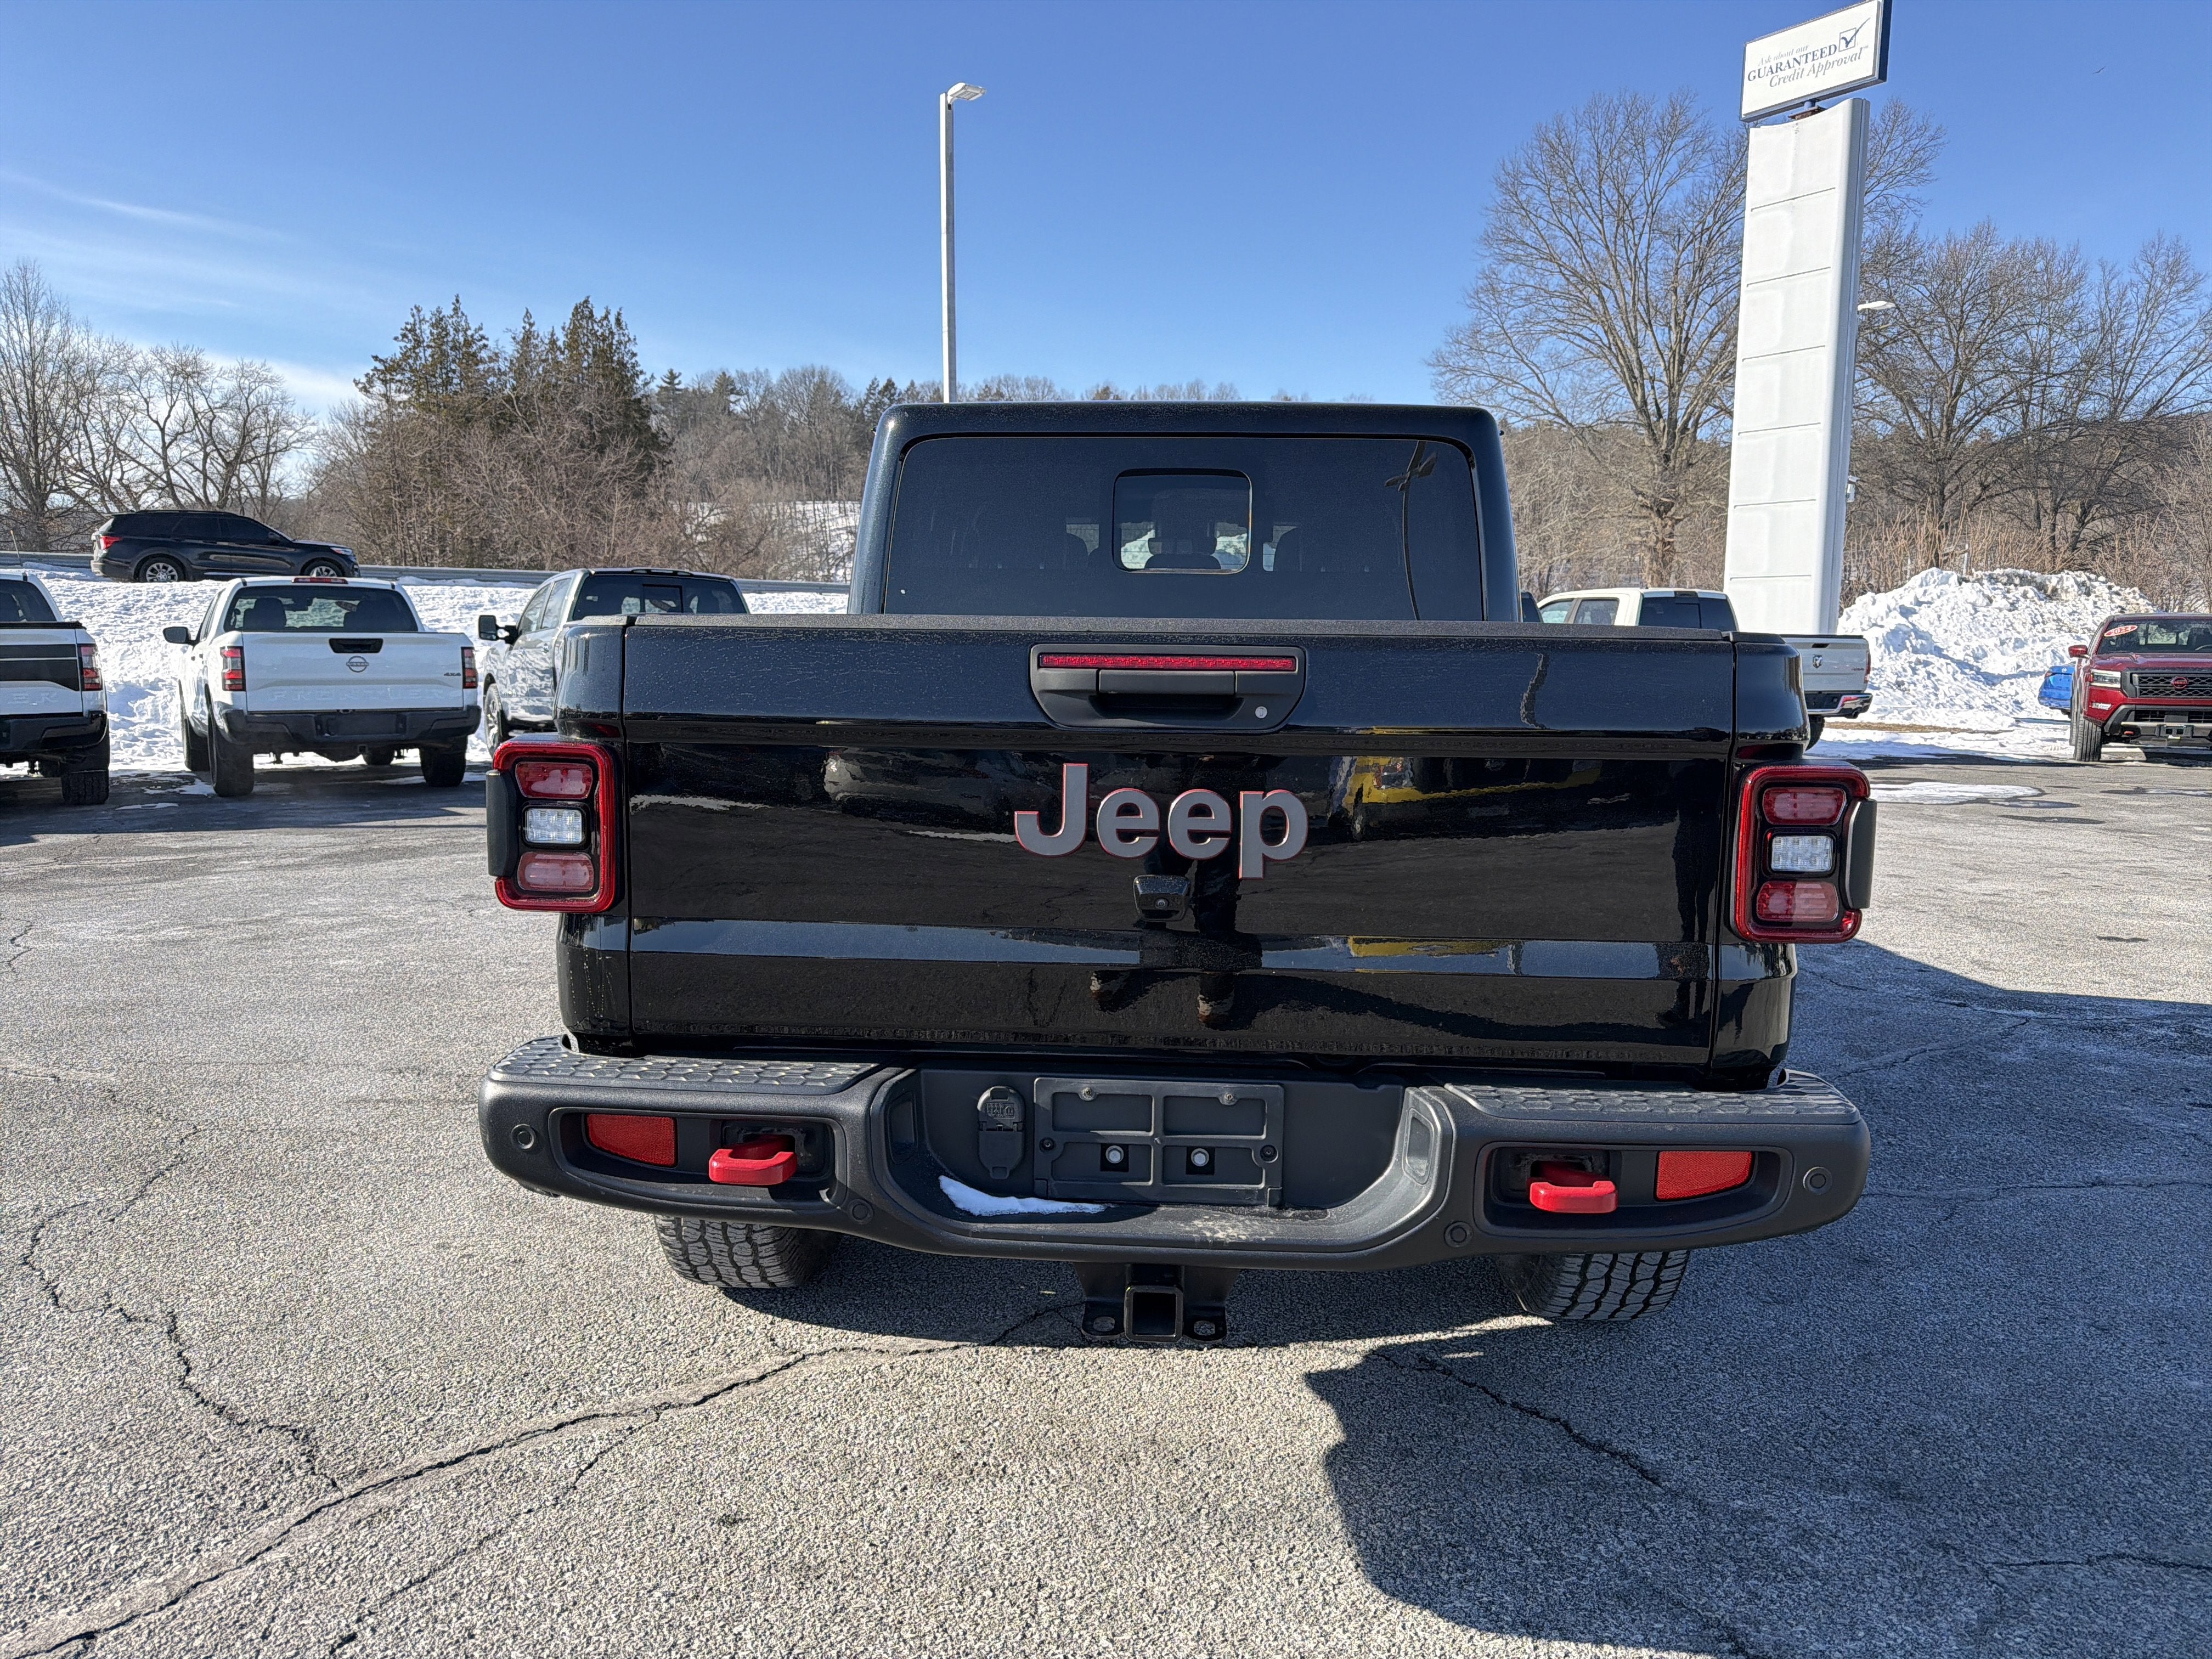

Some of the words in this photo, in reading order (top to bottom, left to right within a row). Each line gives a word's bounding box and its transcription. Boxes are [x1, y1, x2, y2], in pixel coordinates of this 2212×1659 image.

[1747, 44, 1837, 82] GUARANTEED
[1769, 67, 1805, 88] Credit
[1807, 47, 1863, 78] Approval
[1014, 763, 1309, 879] Jeep
